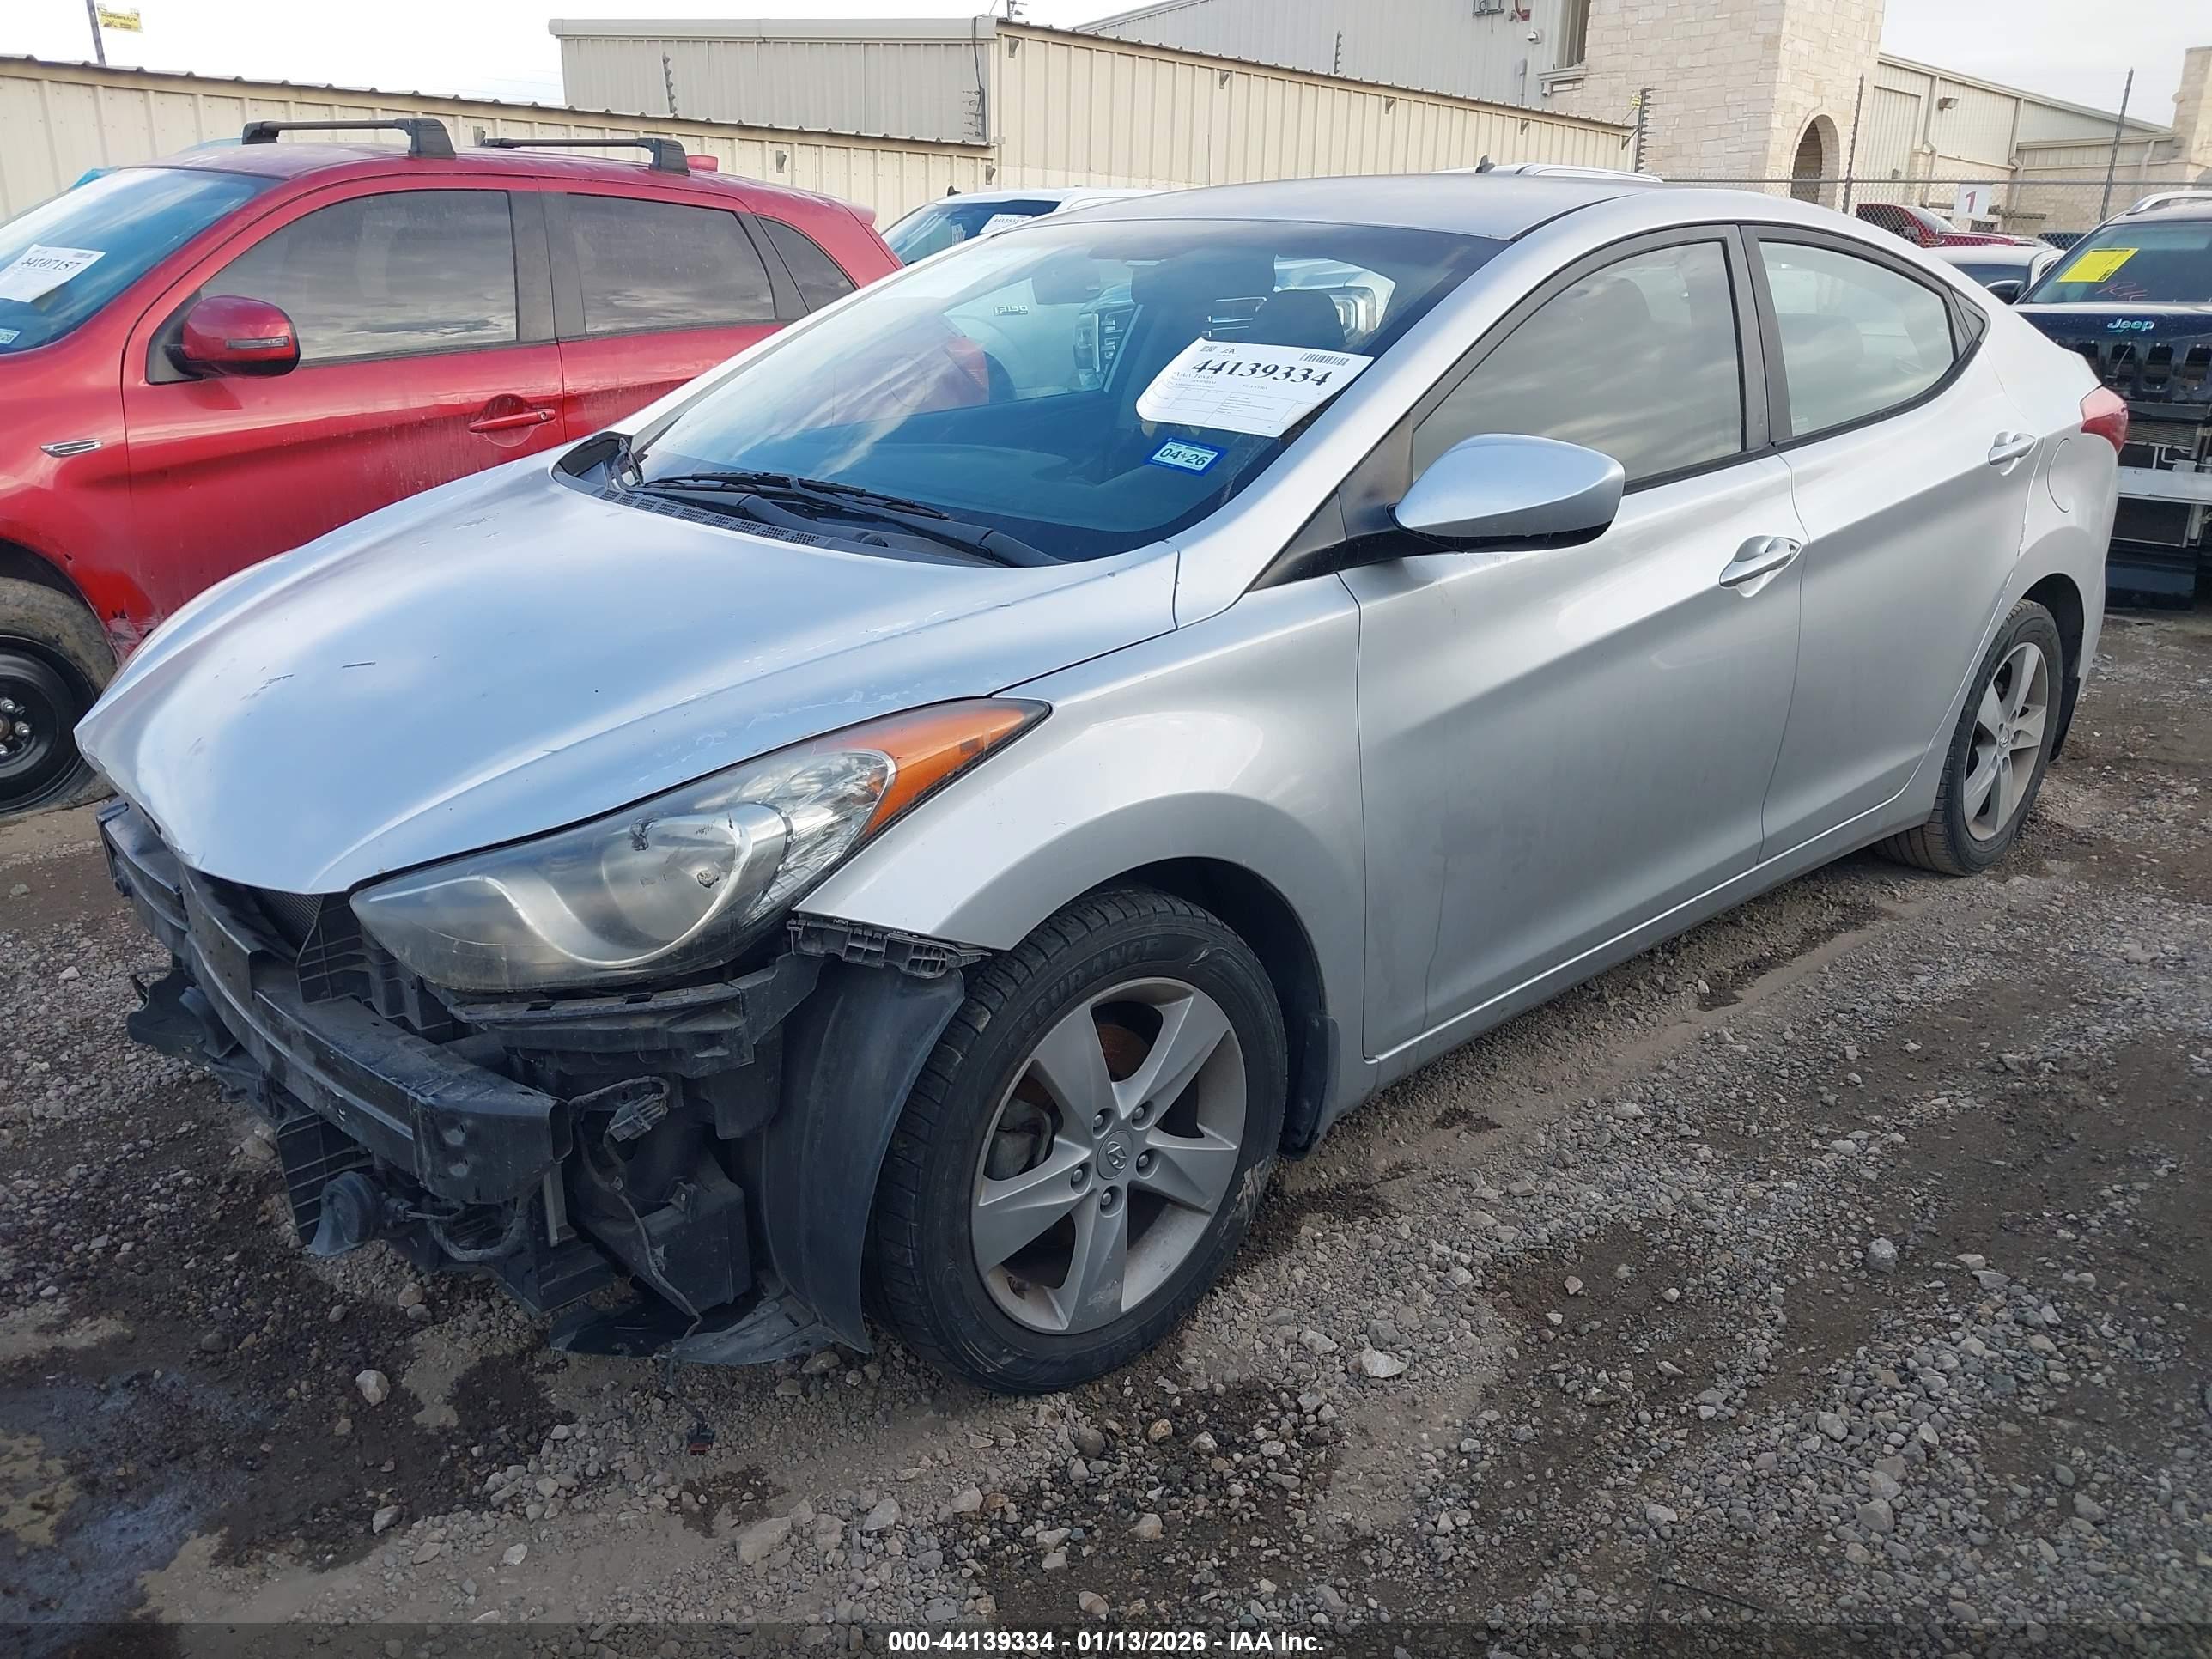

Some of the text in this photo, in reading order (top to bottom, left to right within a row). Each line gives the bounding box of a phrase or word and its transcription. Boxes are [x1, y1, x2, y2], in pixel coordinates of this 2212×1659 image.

[1965, 191, 1978, 214] 1
[2106, 318, 2155, 332] Jeep
[1191, 358, 1333, 386] 44139334
